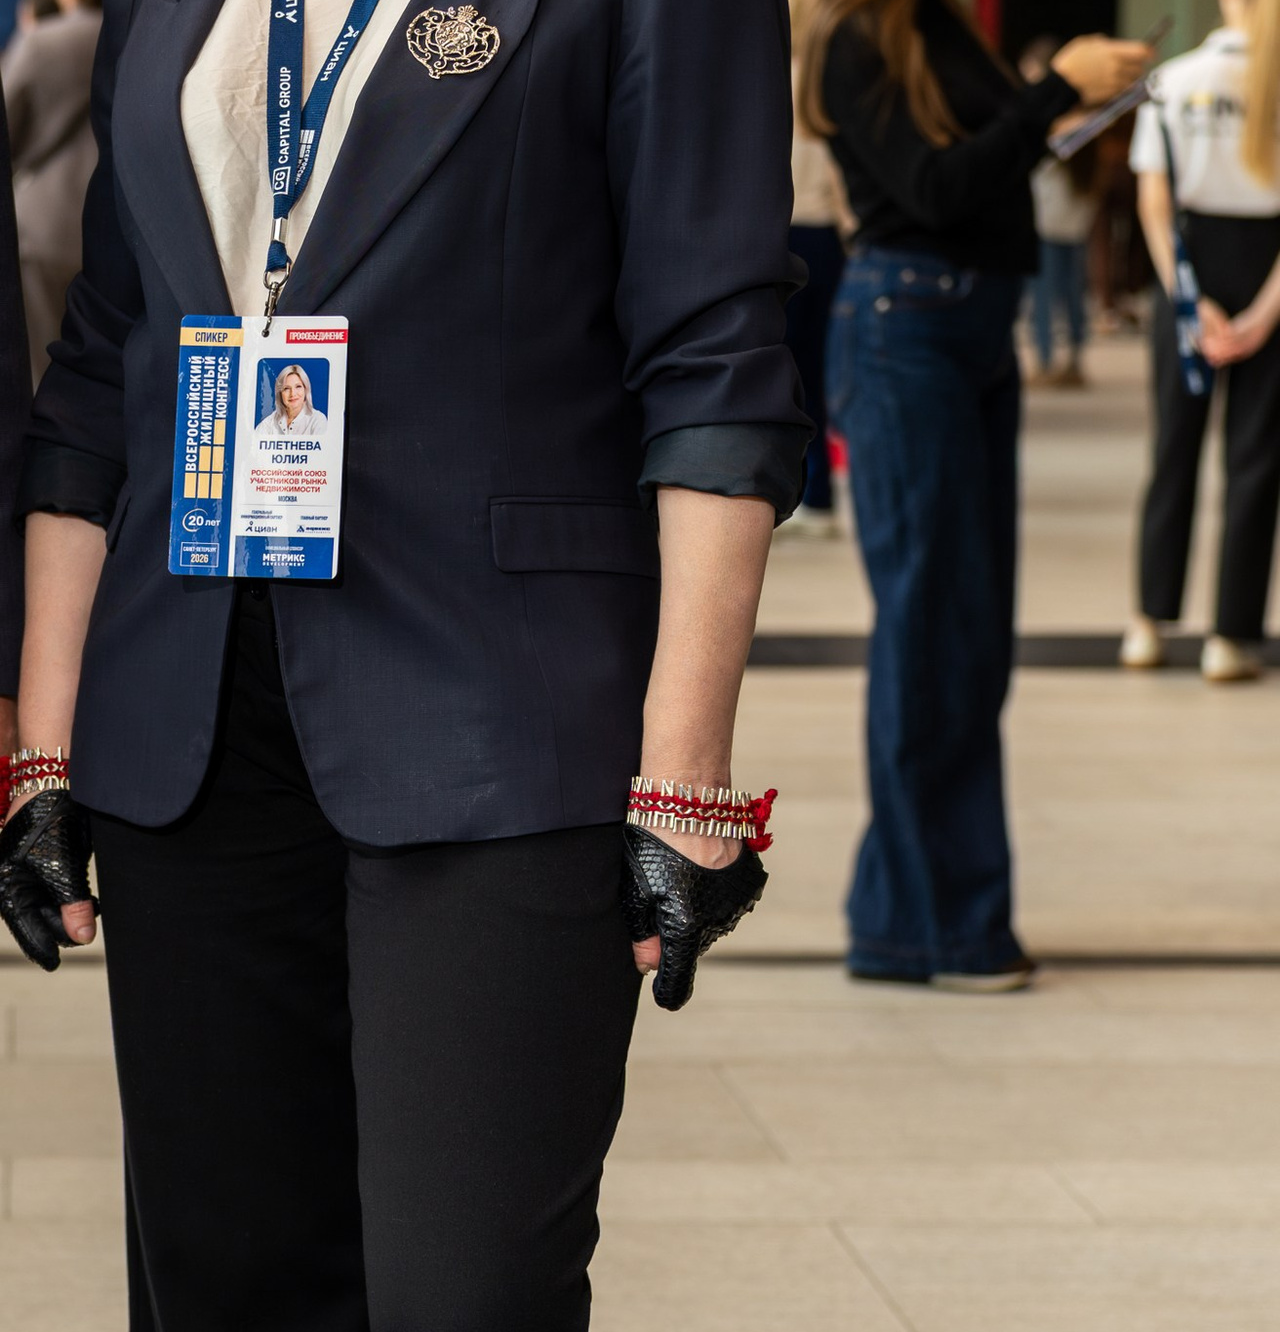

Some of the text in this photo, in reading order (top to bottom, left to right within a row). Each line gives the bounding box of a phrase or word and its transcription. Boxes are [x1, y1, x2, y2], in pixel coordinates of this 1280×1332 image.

[274, 66, 291, 190] CG CAPITAL GROUP
[195, 332, 228, 343] СПИКЕР
[289, 331, 345, 341] ПРОФОБЪЕДИНЕНИЕ
[215, 356, 230, 418] КОНГРЕСС
[200, 355, 216, 444] ЖИЛИЩНЫЙ
[185, 355, 202, 471] ВСЕРОССИЙСКИЙ
[259, 440, 321, 451] ПЛЕТНЕВА
[271, 454, 308, 464] ЮЛИЯ
[251, 469, 303, 477] РОССИЙСКИЙ
[256, 485, 320, 493] НЕДВИЖИМОСТИ
[188, 515, 204, 526] 20
[190, 553, 209, 563] 2026
[262, 553, 305, 562] МЕТРИКС
